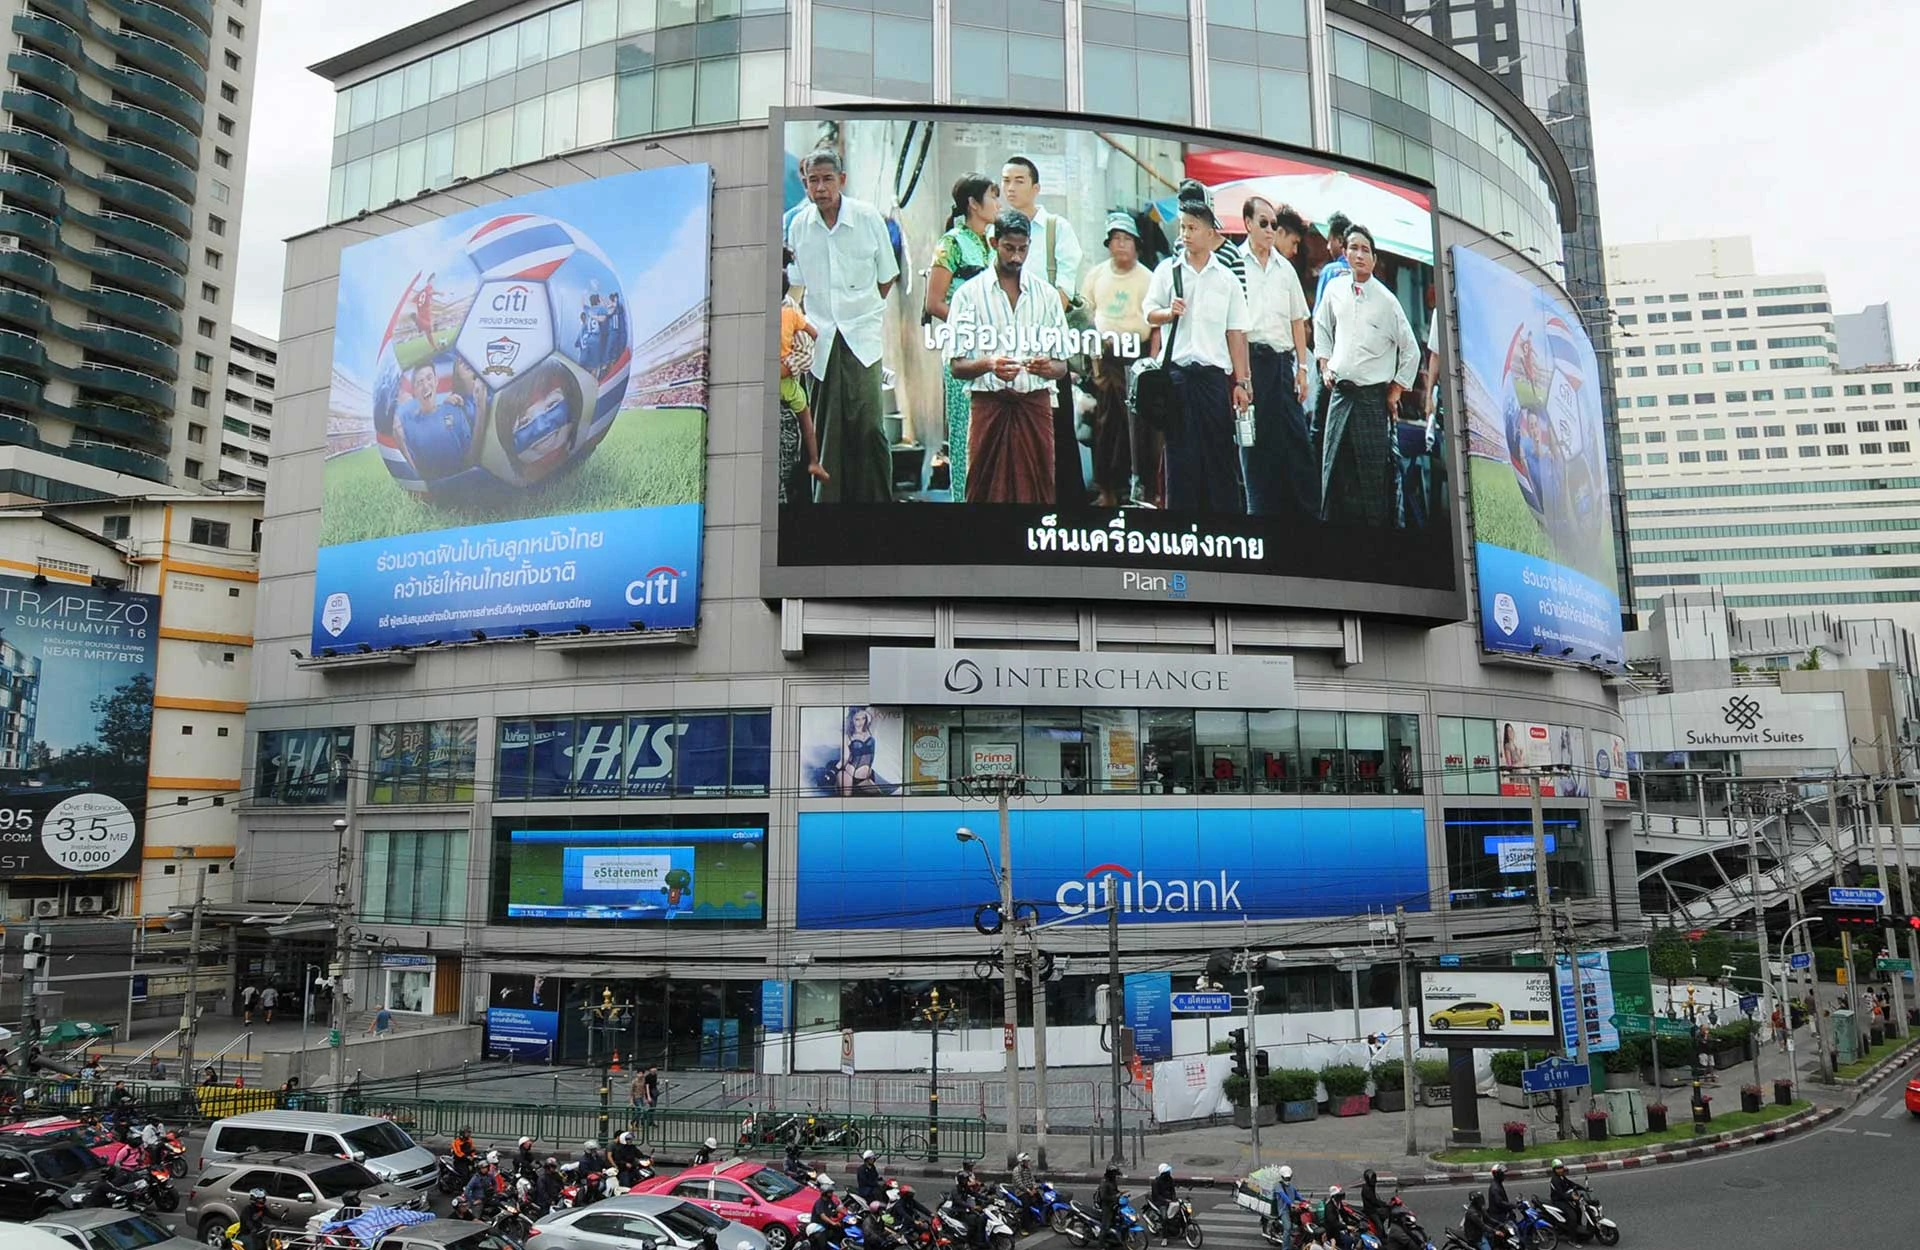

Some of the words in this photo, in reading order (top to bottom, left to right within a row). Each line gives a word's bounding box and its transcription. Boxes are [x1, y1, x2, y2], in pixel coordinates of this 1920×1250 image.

[492, 286, 529, 312] citi
[504, 317, 539, 326] SPONSOR
[923, 304, 1141, 359] เครื่องแต่งกาย
[1027, 511, 1264, 560] เห็นเครื่องแต่งกาย
[625, 567, 679, 606] citi
[1123, 571, 1167, 591] Plan
[1173, 573, 1187, 592] B
[0, 587, 148, 626] TRAPEZO
[15, 615, 120, 636] SUKHUMVIT
[128, 628, 147, 639] 16
[42, 646, 80, 659] NEAR
[84, 650, 144, 664] MRT/BTS
[995, 666, 1230, 692] INTERCHANGE
[1686, 730, 1760, 744] Sukhumvit
[1763, 728, 1804, 743] Suites
[975, 752, 1012, 763] Prima
[975, 761, 1012, 772] dental
[56, 817, 107, 841] 3.5
[109, 832, 128, 841] MB
[593, 867, 659, 878] eStatement
[1055, 866, 1243, 915] citibank
